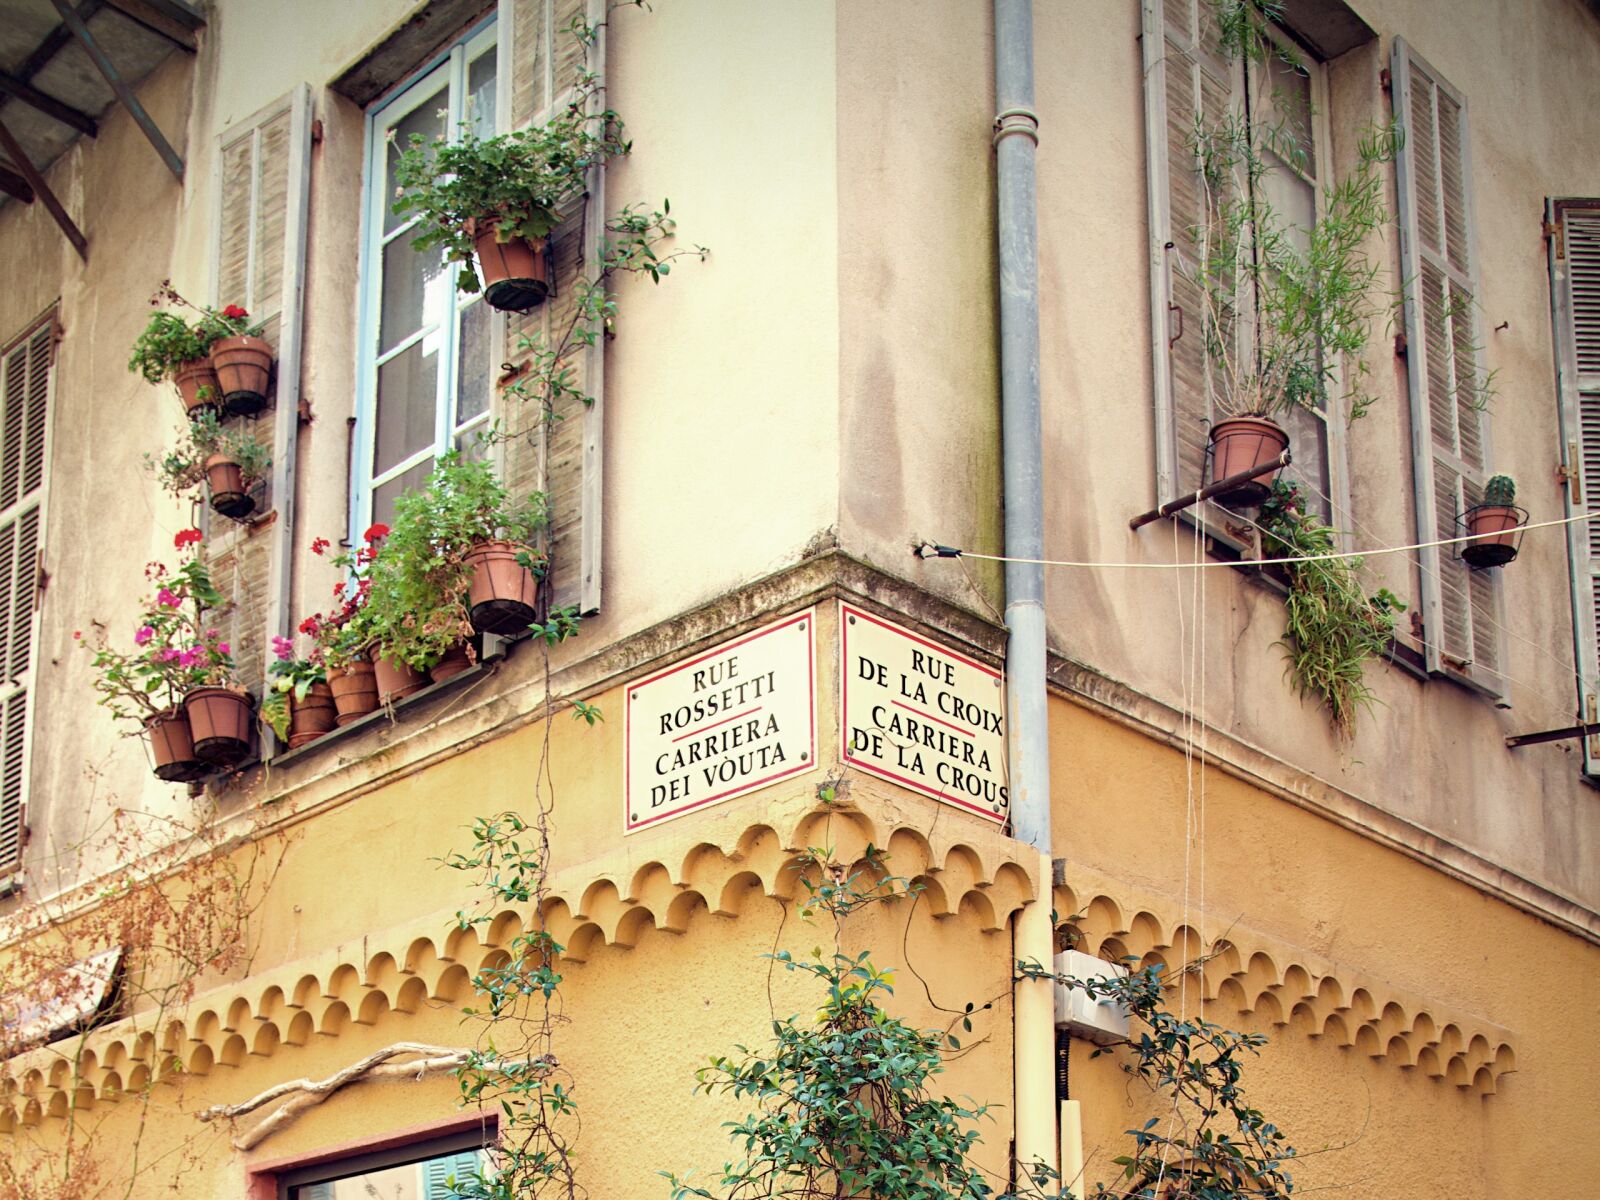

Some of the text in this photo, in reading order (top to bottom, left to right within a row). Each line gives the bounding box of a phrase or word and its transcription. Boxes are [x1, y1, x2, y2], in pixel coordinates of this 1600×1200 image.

[693, 656, 738, 693] RUE
[858, 656, 1003, 736] DE LA CROIX
[912, 649, 955, 686] RUE
[659, 671, 775, 735] ROSSETTI
[655, 713, 780, 775] CARRIERA
[853, 727, 1009, 808] DE LA CROUS
[872, 706, 991, 772] CARRIERA
[651, 742, 786, 808] DEI VÒUTA
